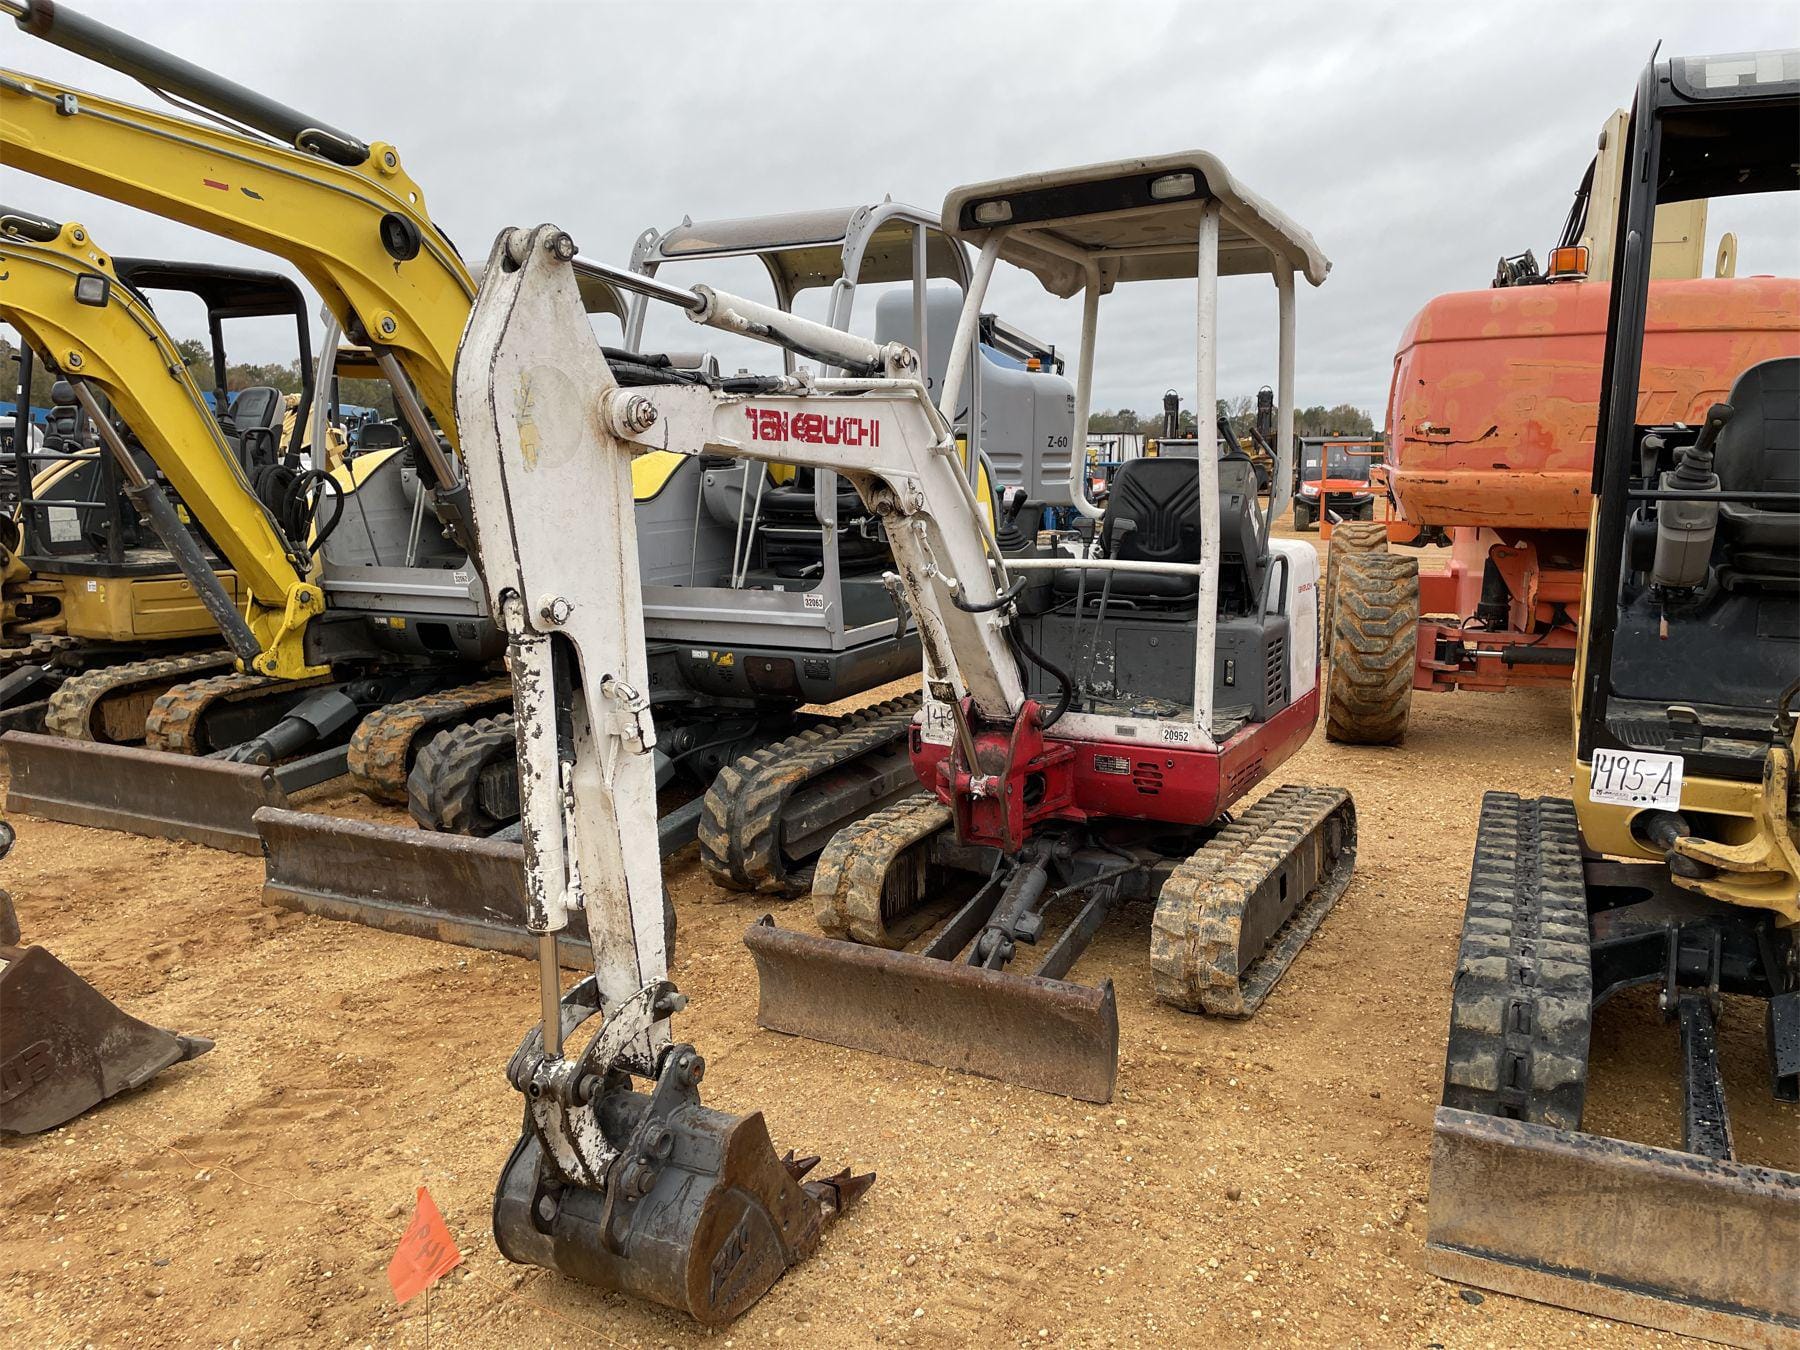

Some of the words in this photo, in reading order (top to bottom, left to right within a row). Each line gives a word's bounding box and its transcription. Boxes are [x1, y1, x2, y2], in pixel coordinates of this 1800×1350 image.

[1048, 436, 1068, 448] Z-60
[1164, 730, 1189, 742] 20952
[1591, 753, 1673, 796] 1495-A
